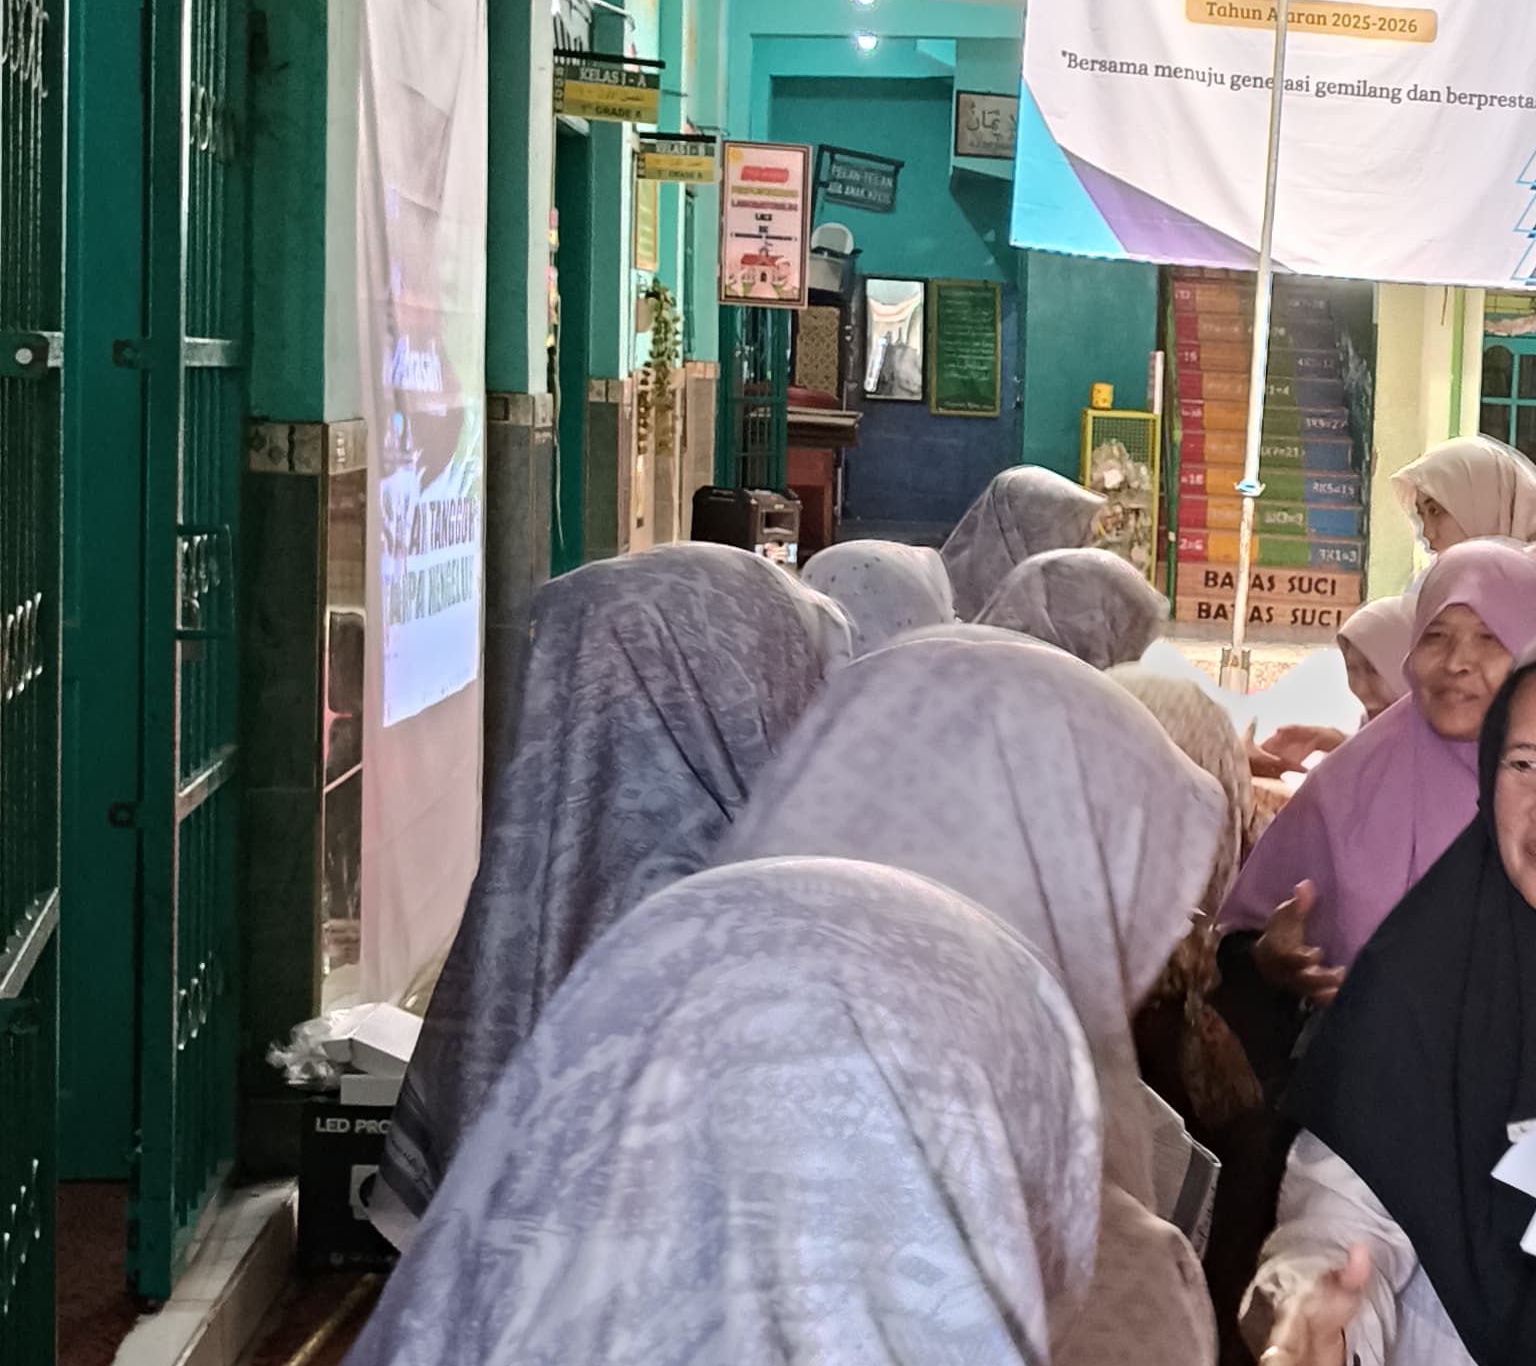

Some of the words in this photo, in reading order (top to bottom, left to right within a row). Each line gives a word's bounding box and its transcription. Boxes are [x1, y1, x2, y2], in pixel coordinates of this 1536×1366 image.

[1206, 1, 1263, 22] Tahun
[1266, 6, 1328, 27] Aaran
[1331, 12, 1419, 34] 2025-2026
[580, 67, 619, 85] KELAS
[1153, 63, 1226, 88] menuju
[1230, 72, 1310, 94] geneasi
[1314, 79, 1403, 105] gemilang
[1406, 84, 1442, 104] dan
[1204, 570, 1276, 592] BAAS
[1288, 576, 1336, 596] SUCI
[1198, 602, 1274, 624] BAAS
[1290, 608, 1342, 628] SUCI
[316, 1116, 350, 1133] LED
